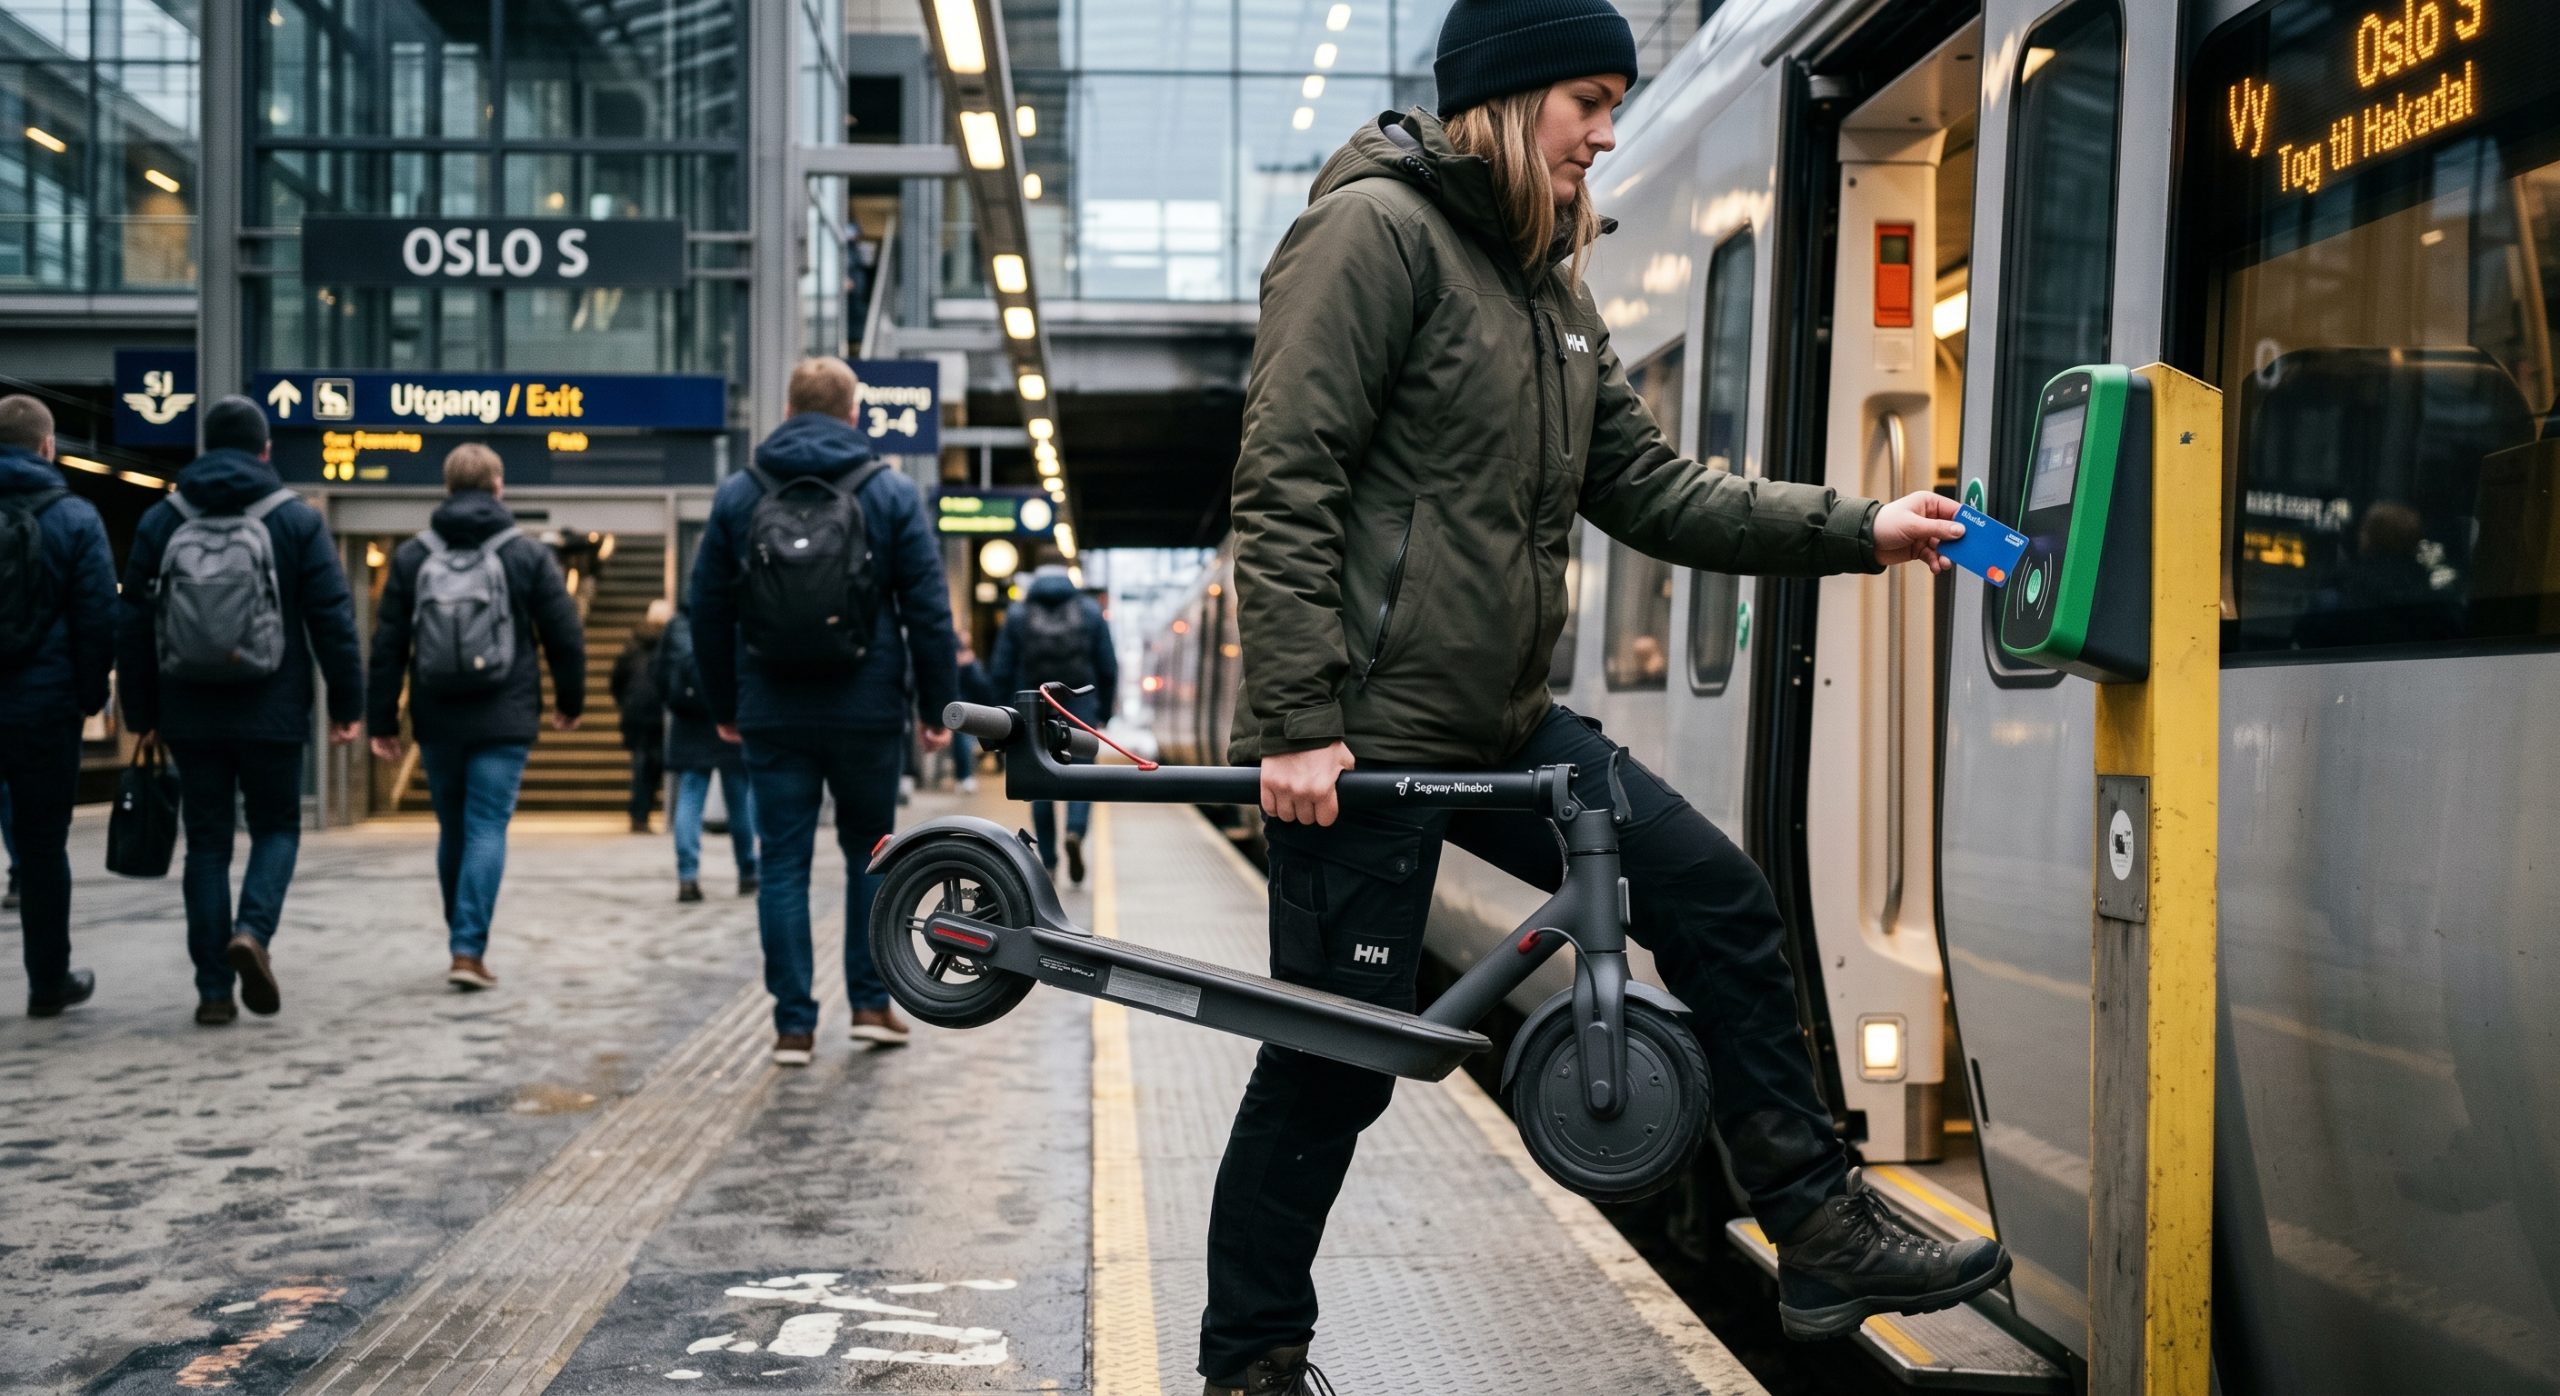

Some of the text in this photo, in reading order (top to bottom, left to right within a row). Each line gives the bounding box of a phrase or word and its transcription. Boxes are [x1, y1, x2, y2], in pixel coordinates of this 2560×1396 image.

[2356, 0, 2440, 87] Oslo
[2229, 77, 2270, 157] Vy
[2278, 60, 2473, 193] Tog til Hakadal
[402, 226, 590, 278] OSLO S
[1565, 332, 1590, 353] HH
[390, 382, 584, 423] Utgang / Exit
[867, 407, 918, 438] 3-4
[1414, 782, 1493, 795] Segway-Ninebot
[1353, 943, 1390, 965] HH
